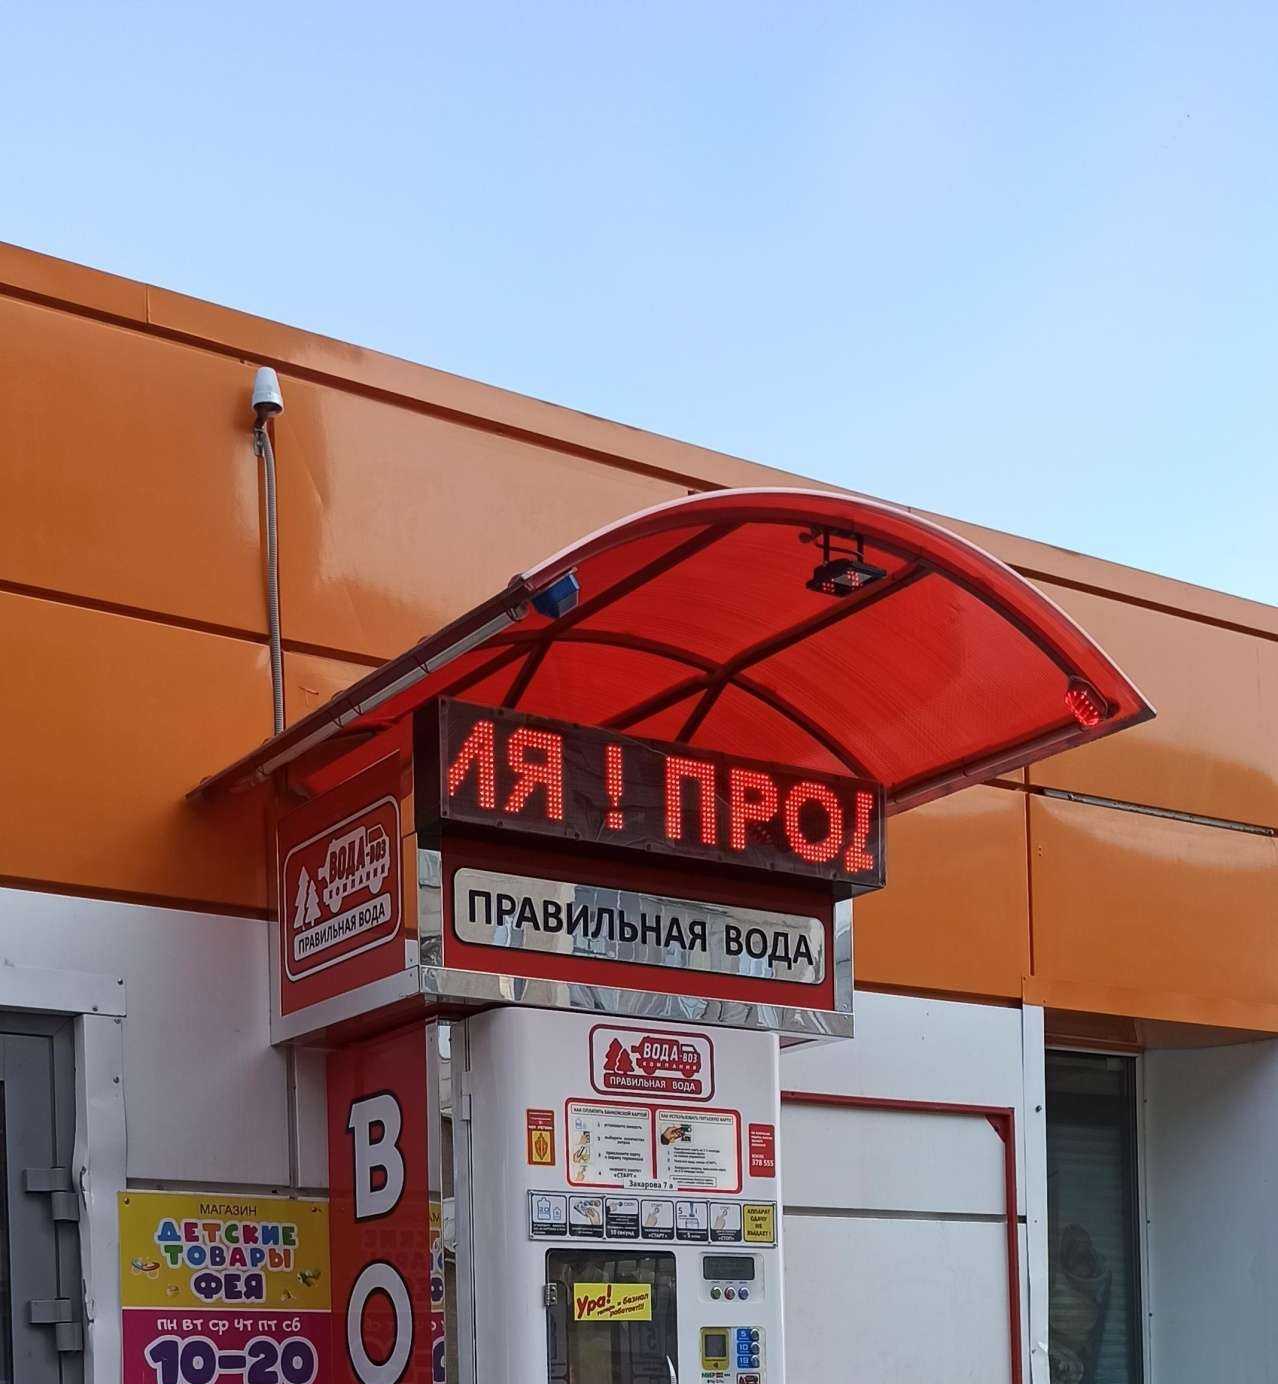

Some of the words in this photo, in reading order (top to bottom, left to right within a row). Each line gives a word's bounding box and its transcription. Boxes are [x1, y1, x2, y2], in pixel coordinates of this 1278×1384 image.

[298, 914, 357, 955] ПРАВИЛЬНАЯ
[359, 902, 386, 928] ВОДА
[468, 889, 707, 952] ПРАВИЛЬНАЯ
[725, 924, 814, 970] ВОДА
[610, 1076, 666, 1088] ПРАВИЛЬНАЯ
[672, 1082, 696, 1093] ВОДА
[629, 1180, 662, 1190] Захарова
[200, 1203, 257, 1216] МАГАЗИН
[156, 1219, 297, 1247] ДЕТСКИЕ
[163, 1243, 293, 1268] ТОВАРЫ
[192, 1271, 265, 1300] ФЕЯ
[577, 1284, 612, 1319] Ура!
